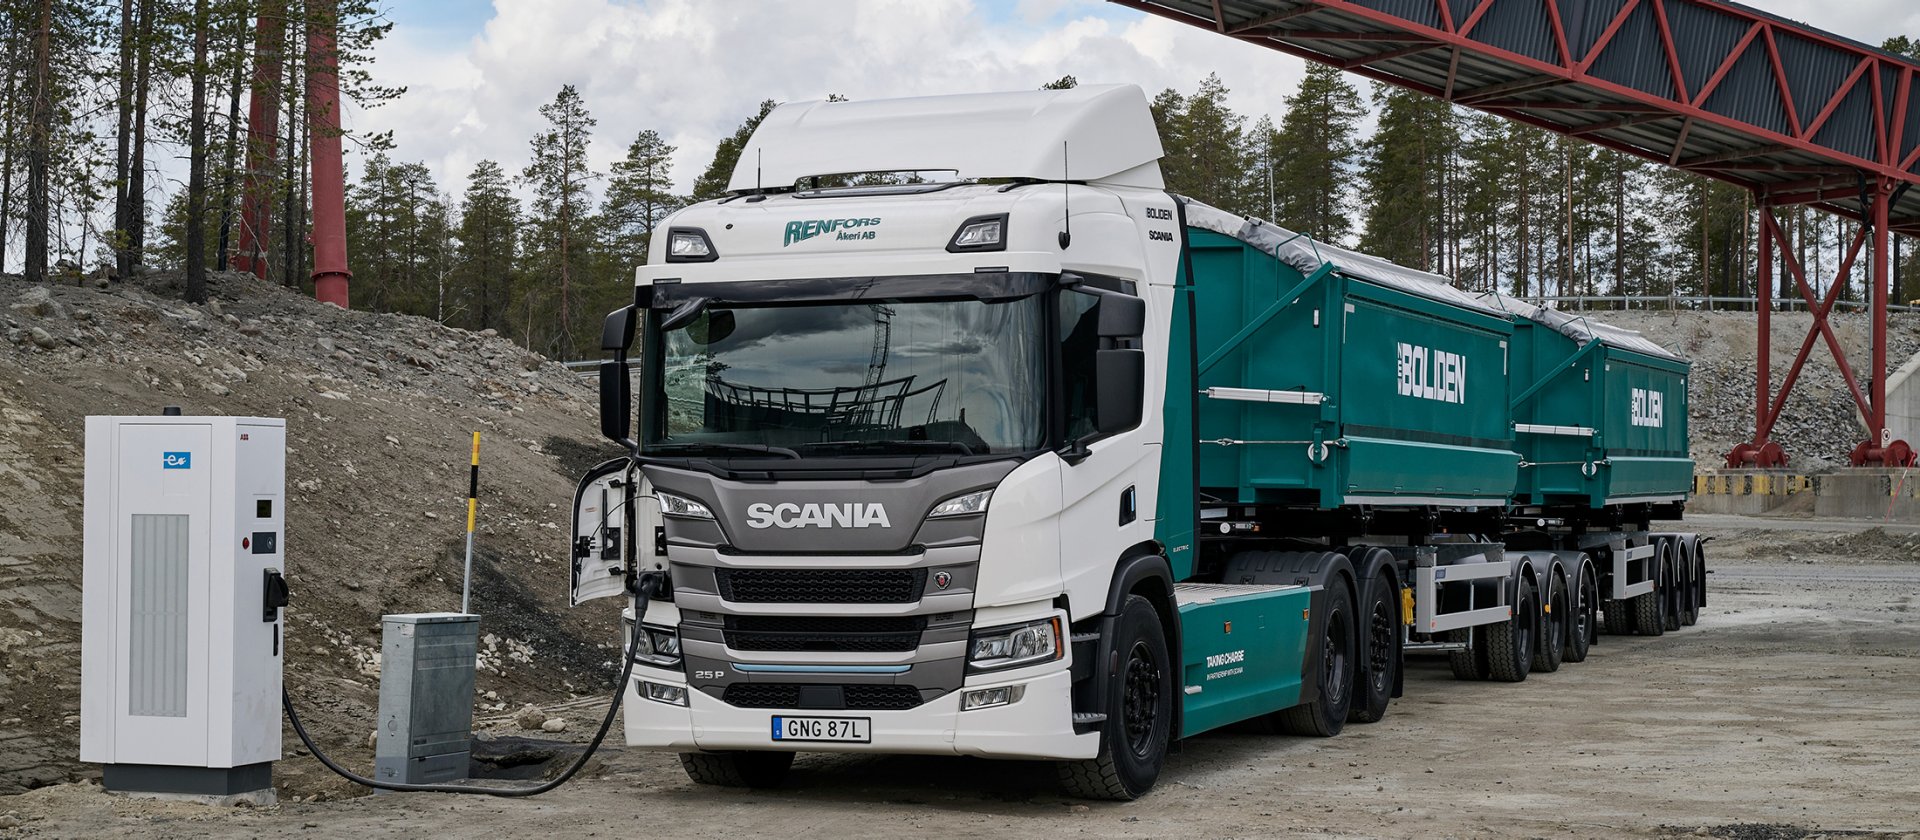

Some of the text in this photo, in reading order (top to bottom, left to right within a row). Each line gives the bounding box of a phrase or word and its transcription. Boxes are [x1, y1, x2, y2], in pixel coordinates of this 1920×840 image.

[1146, 207, 1173, 221] BOLIDEN
[783, 217, 881, 247] RENFORS
[835, 229, 876, 242] Åkeri AB
[1148, 229, 1174, 242] SCANIA
[1401, 342, 1466, 405] BOLIDEN
[1633, 387, 1663, 428] BOLIDEN
[240, 433, 249, 441] ABB
[746, 501, 892, 530] SCANIA
[1206, 649, 1245, 668] TAKING CHARGE
[694, 670, 725, 680] 25 P
[788, 719, 822, 738] GNG
[827, 720, 862, 738] 87L
